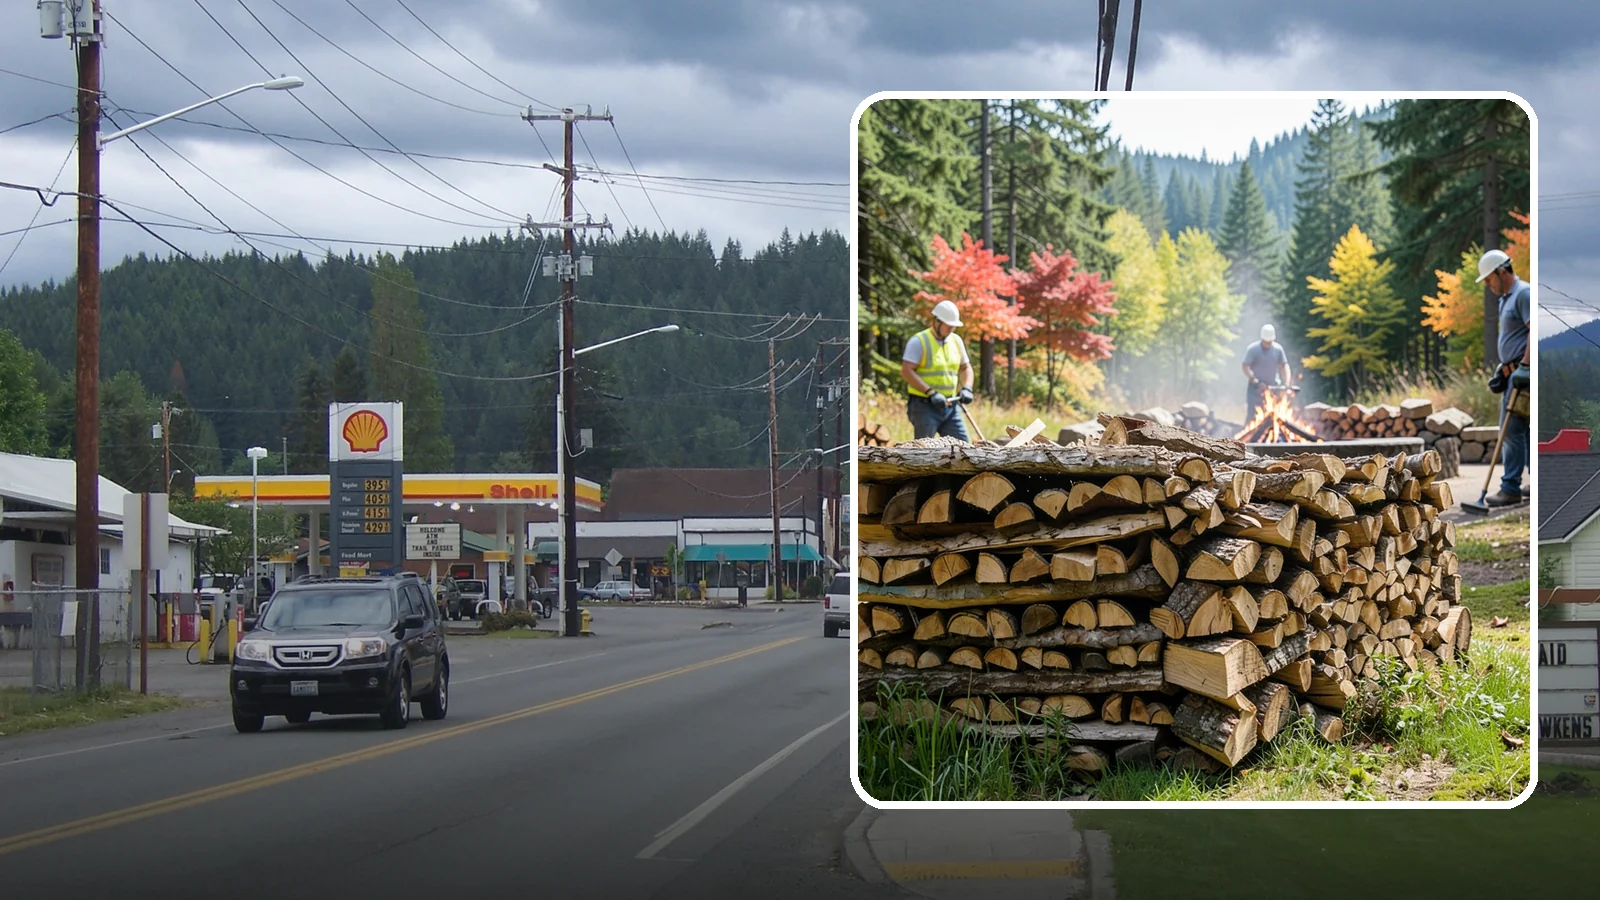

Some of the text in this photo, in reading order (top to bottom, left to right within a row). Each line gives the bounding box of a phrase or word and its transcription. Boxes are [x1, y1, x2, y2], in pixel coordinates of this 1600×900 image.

[365, 480, 383, 490] 395
[490, 484, 547, 499] Shell
[365, 494, 383, 504] 405
[365, 508, 383, 518] 415
[365, 522, 383, 532] 429
